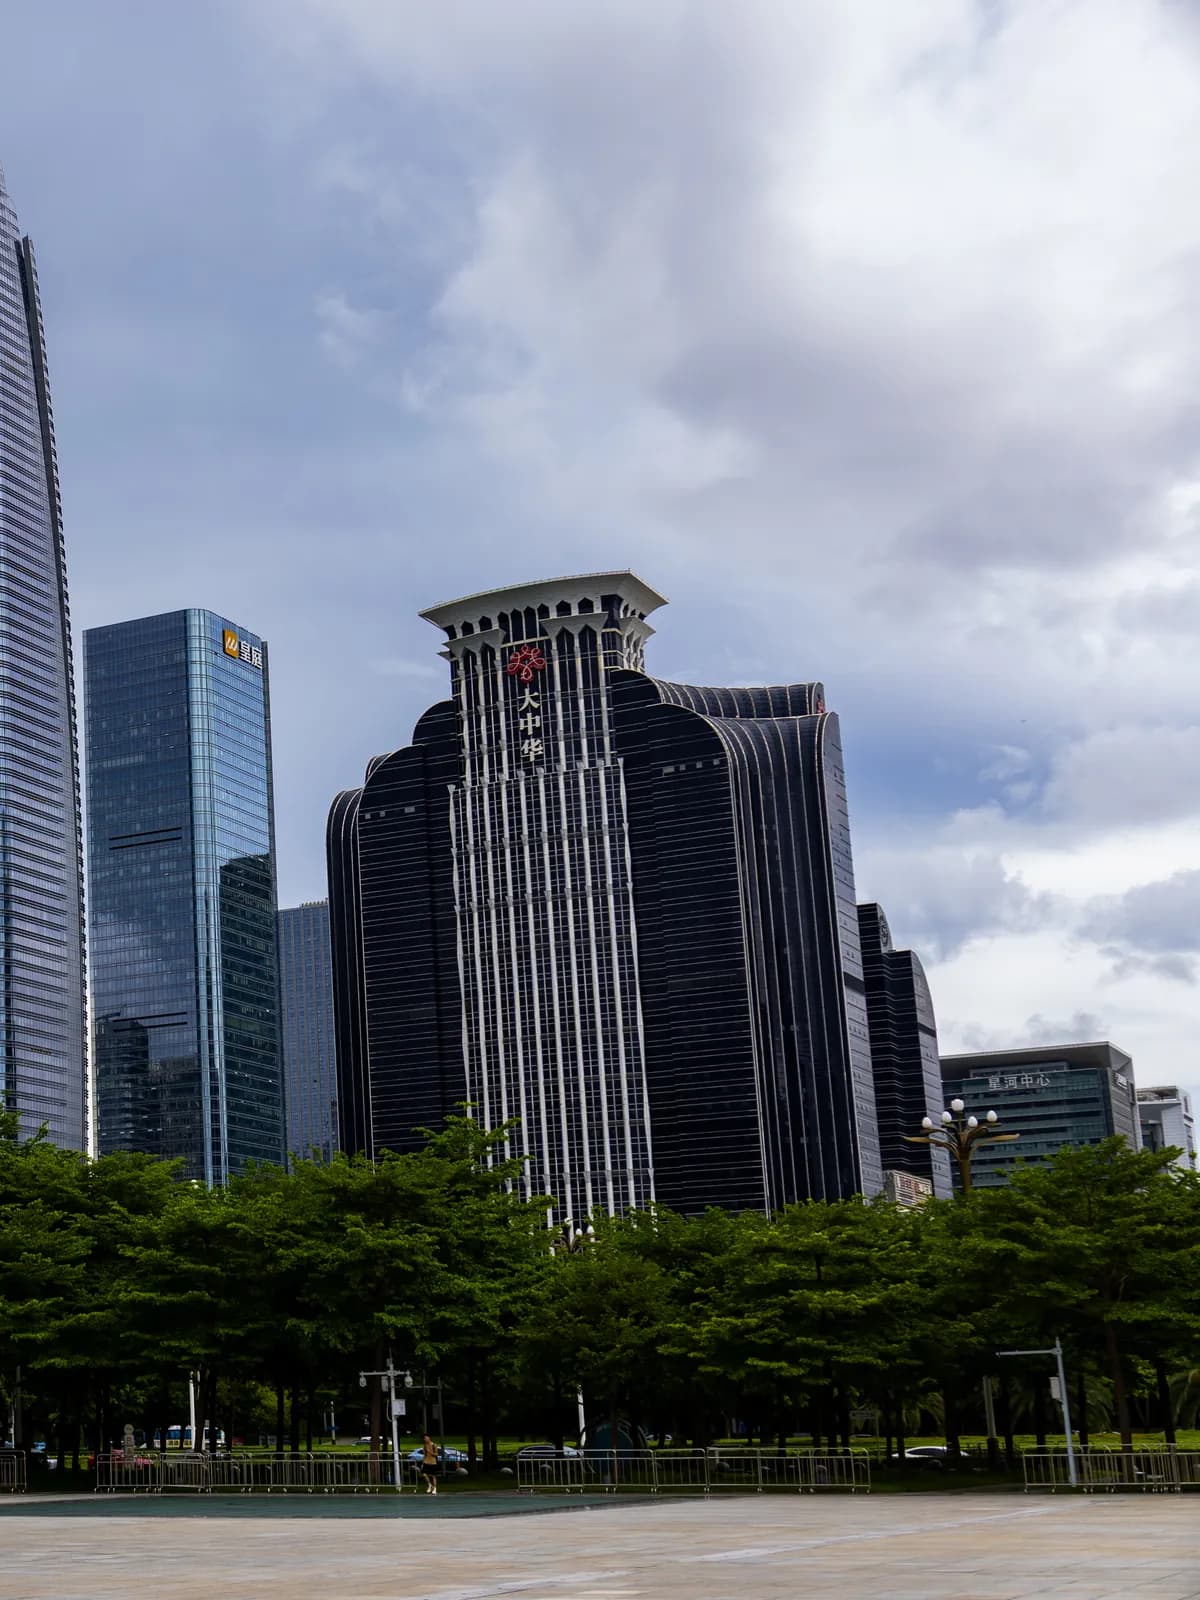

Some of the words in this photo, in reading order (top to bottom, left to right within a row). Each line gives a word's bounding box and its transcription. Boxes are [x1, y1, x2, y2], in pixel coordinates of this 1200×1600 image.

[240, 641, 263, 669] 皇庭
[517, 688, 544, 762] 大中华
[988, 1074, 1050, 1090] 星河中心
